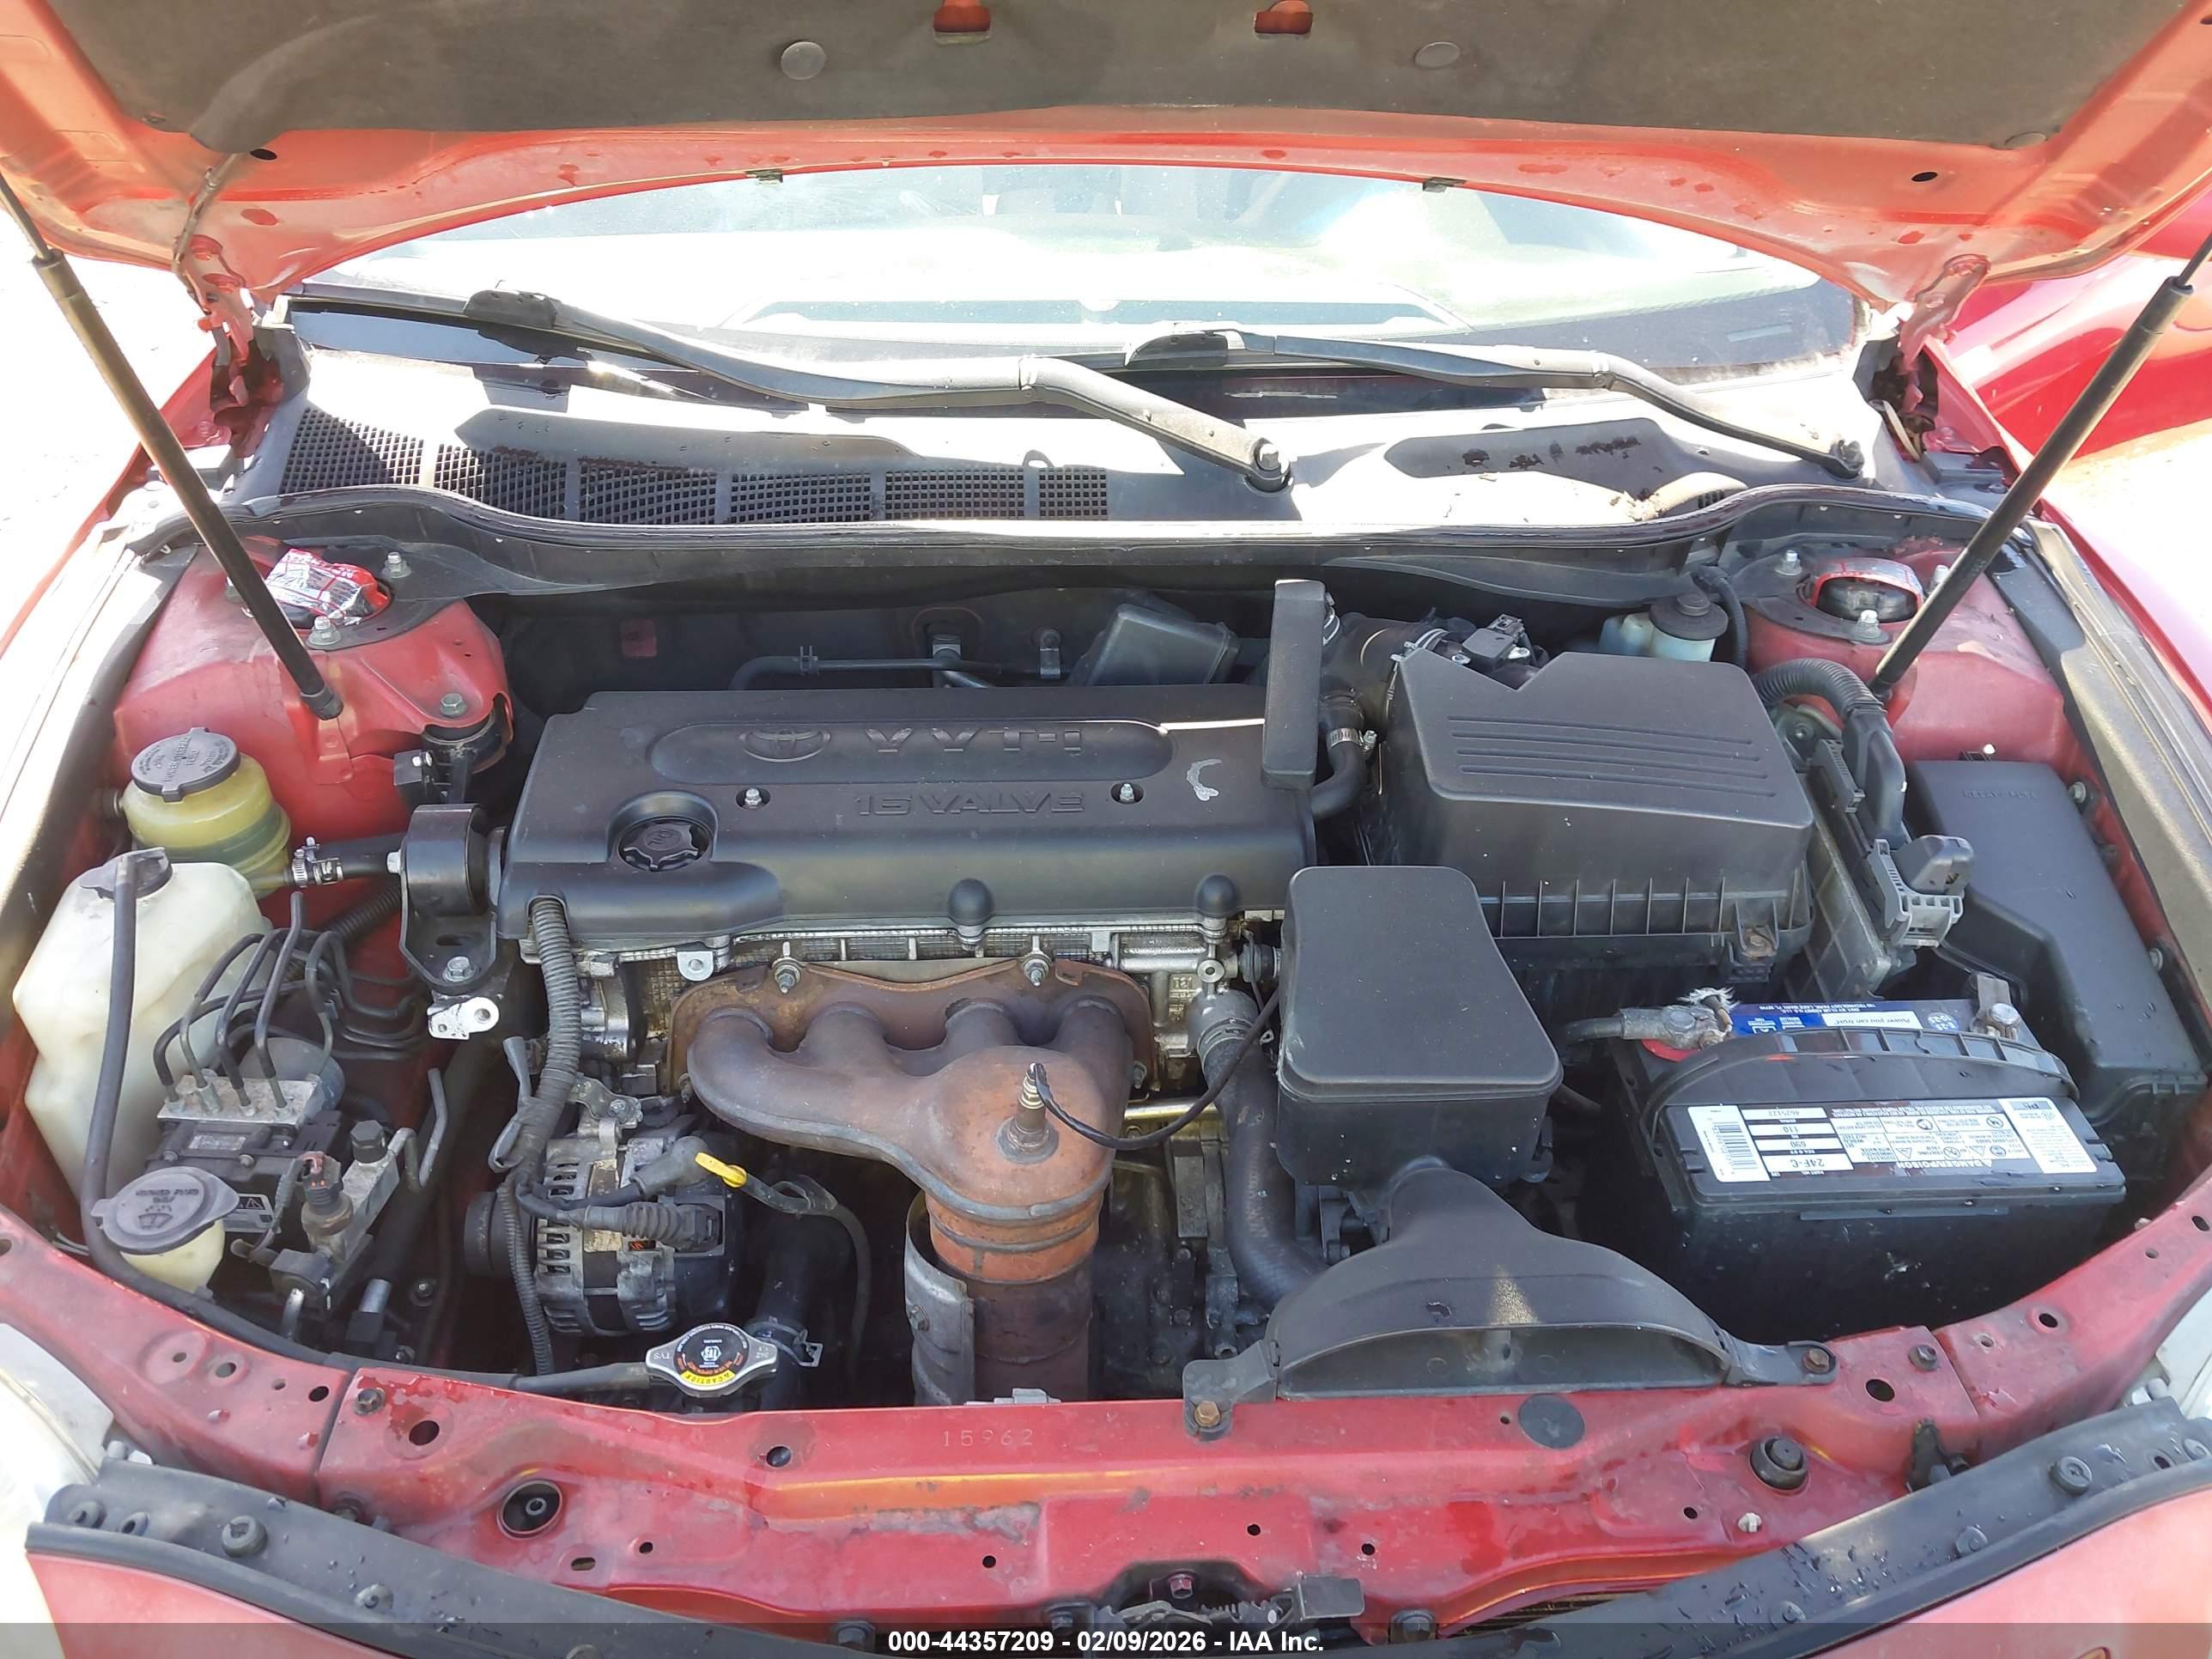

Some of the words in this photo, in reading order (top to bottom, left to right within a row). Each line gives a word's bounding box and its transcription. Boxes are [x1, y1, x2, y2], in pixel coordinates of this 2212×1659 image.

[855, 794, 913, 816] 16
[919, 792, 1085, 815] VALVE
[1790, 1158, 1826, 1169] 24F-C
[684, 1373, 724, 1385] CAUTION
[942, 1428, 1033, 1447] 15962
